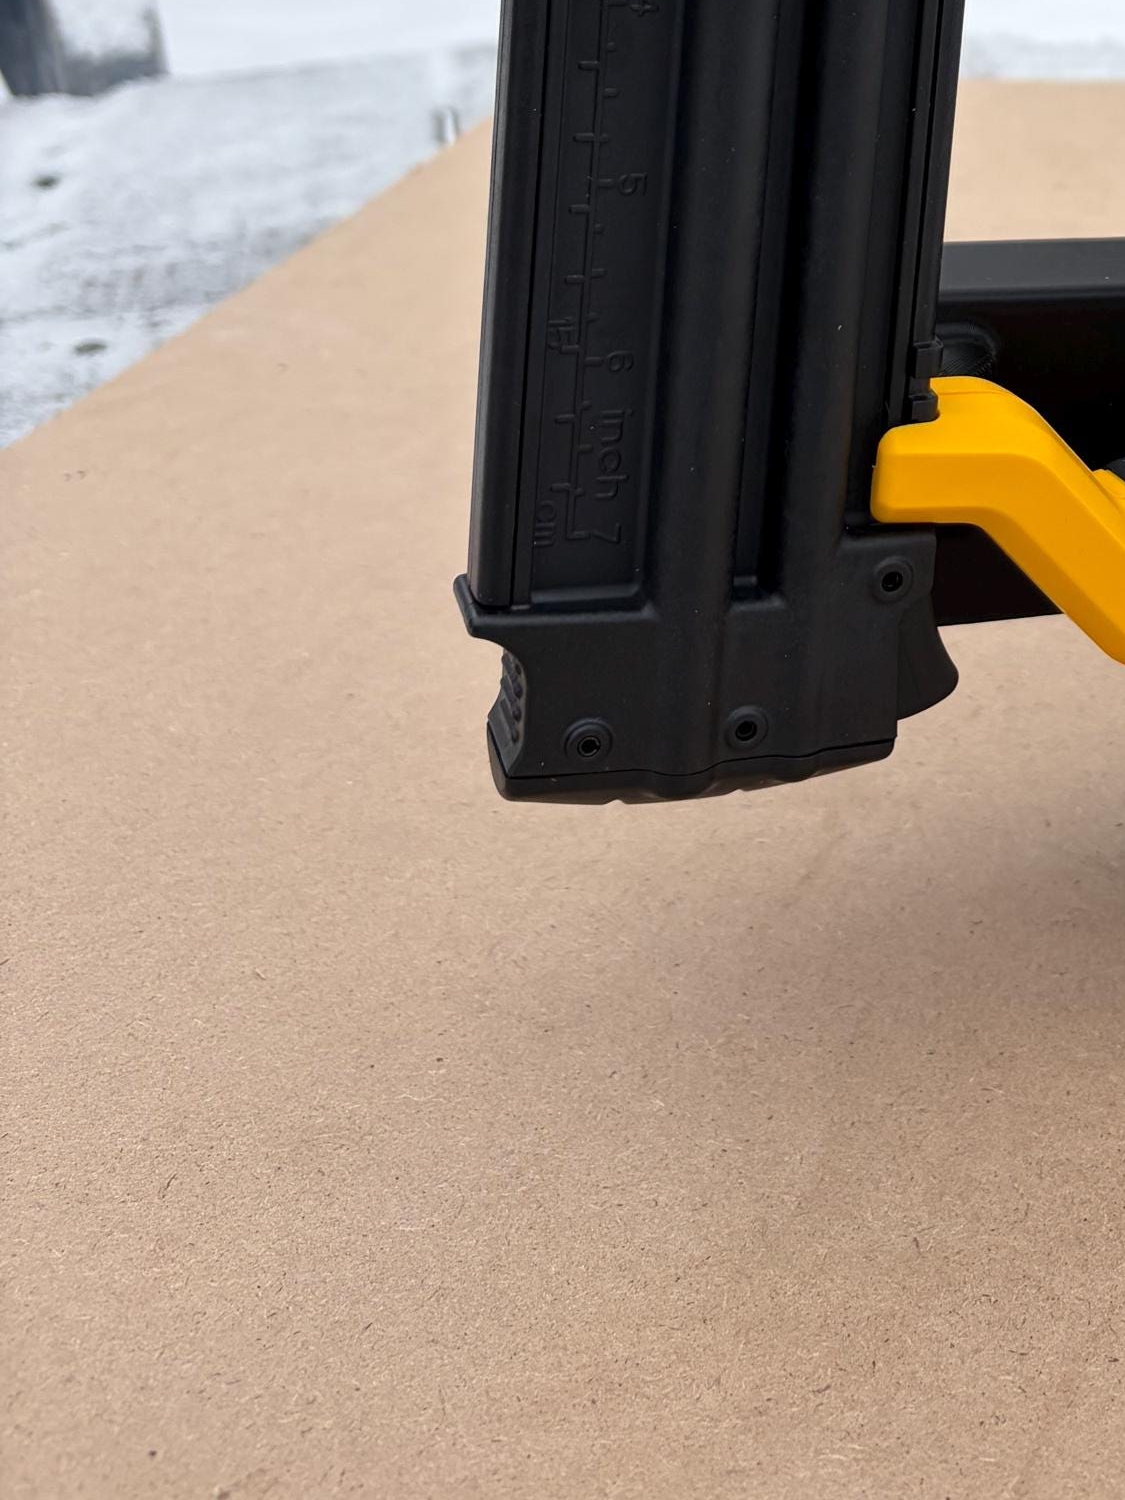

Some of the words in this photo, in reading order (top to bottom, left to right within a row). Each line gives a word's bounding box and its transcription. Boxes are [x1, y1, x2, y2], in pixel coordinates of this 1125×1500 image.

[617, 171, 649, 198] 5
[606, 350, 634, 373] 6
[595, 409, 633, 499] inch
[535, 500, 556, 547] cm
[592, 522, 621, 544] 7
